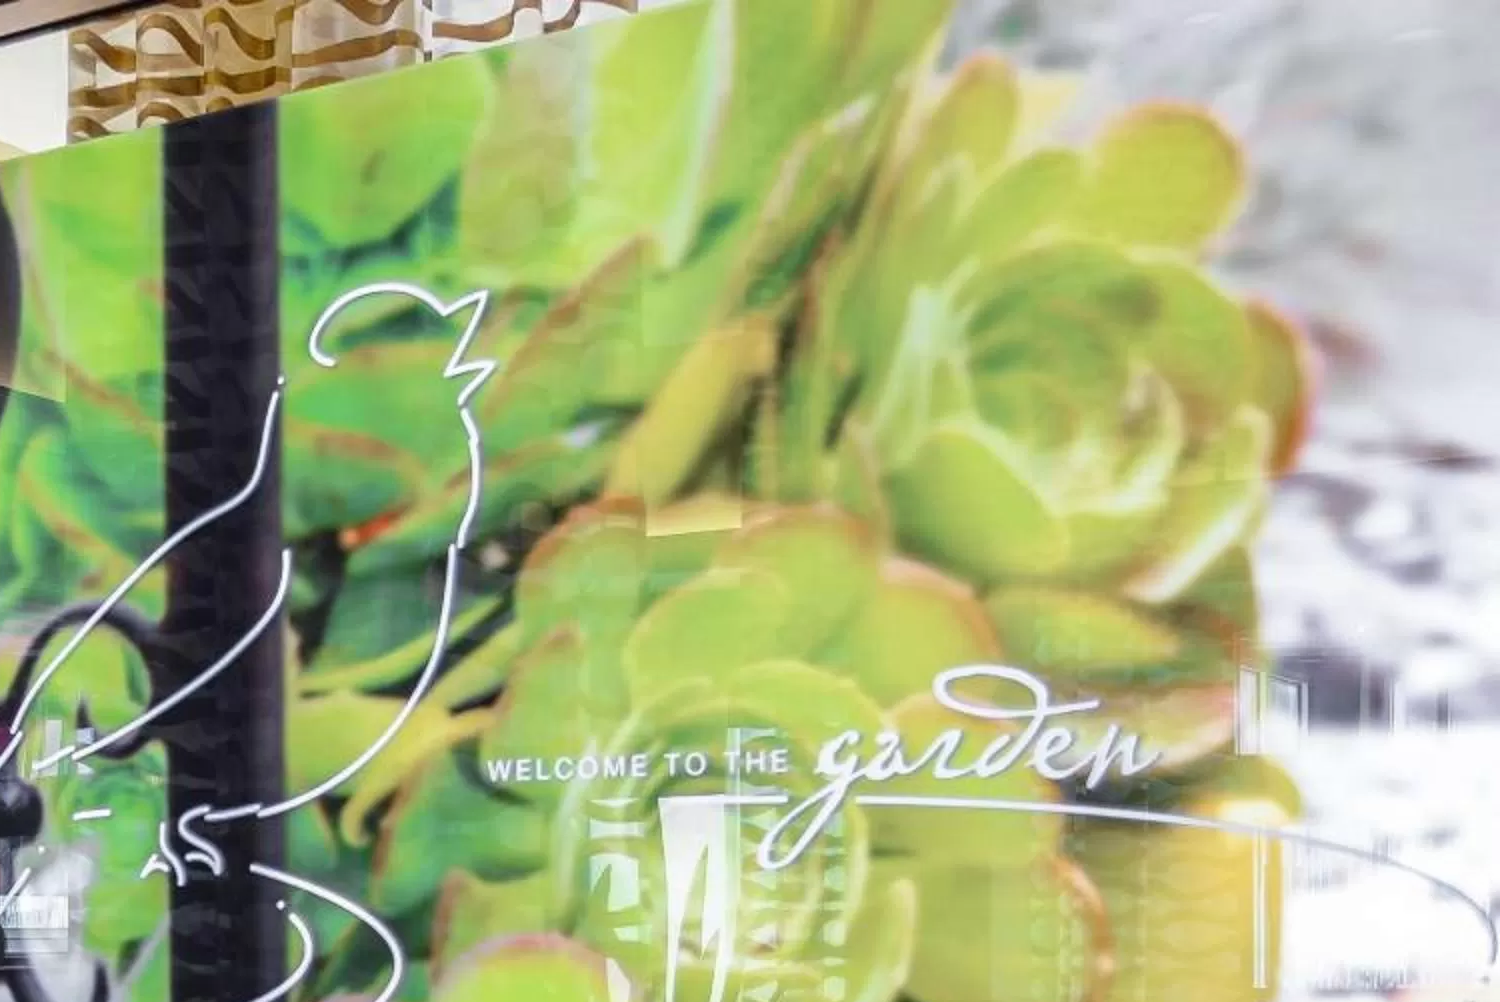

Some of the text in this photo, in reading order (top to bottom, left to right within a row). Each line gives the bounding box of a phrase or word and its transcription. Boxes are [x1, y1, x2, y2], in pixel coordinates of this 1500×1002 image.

[487, 663, 1165, 871] WELCOME TO THE garden
